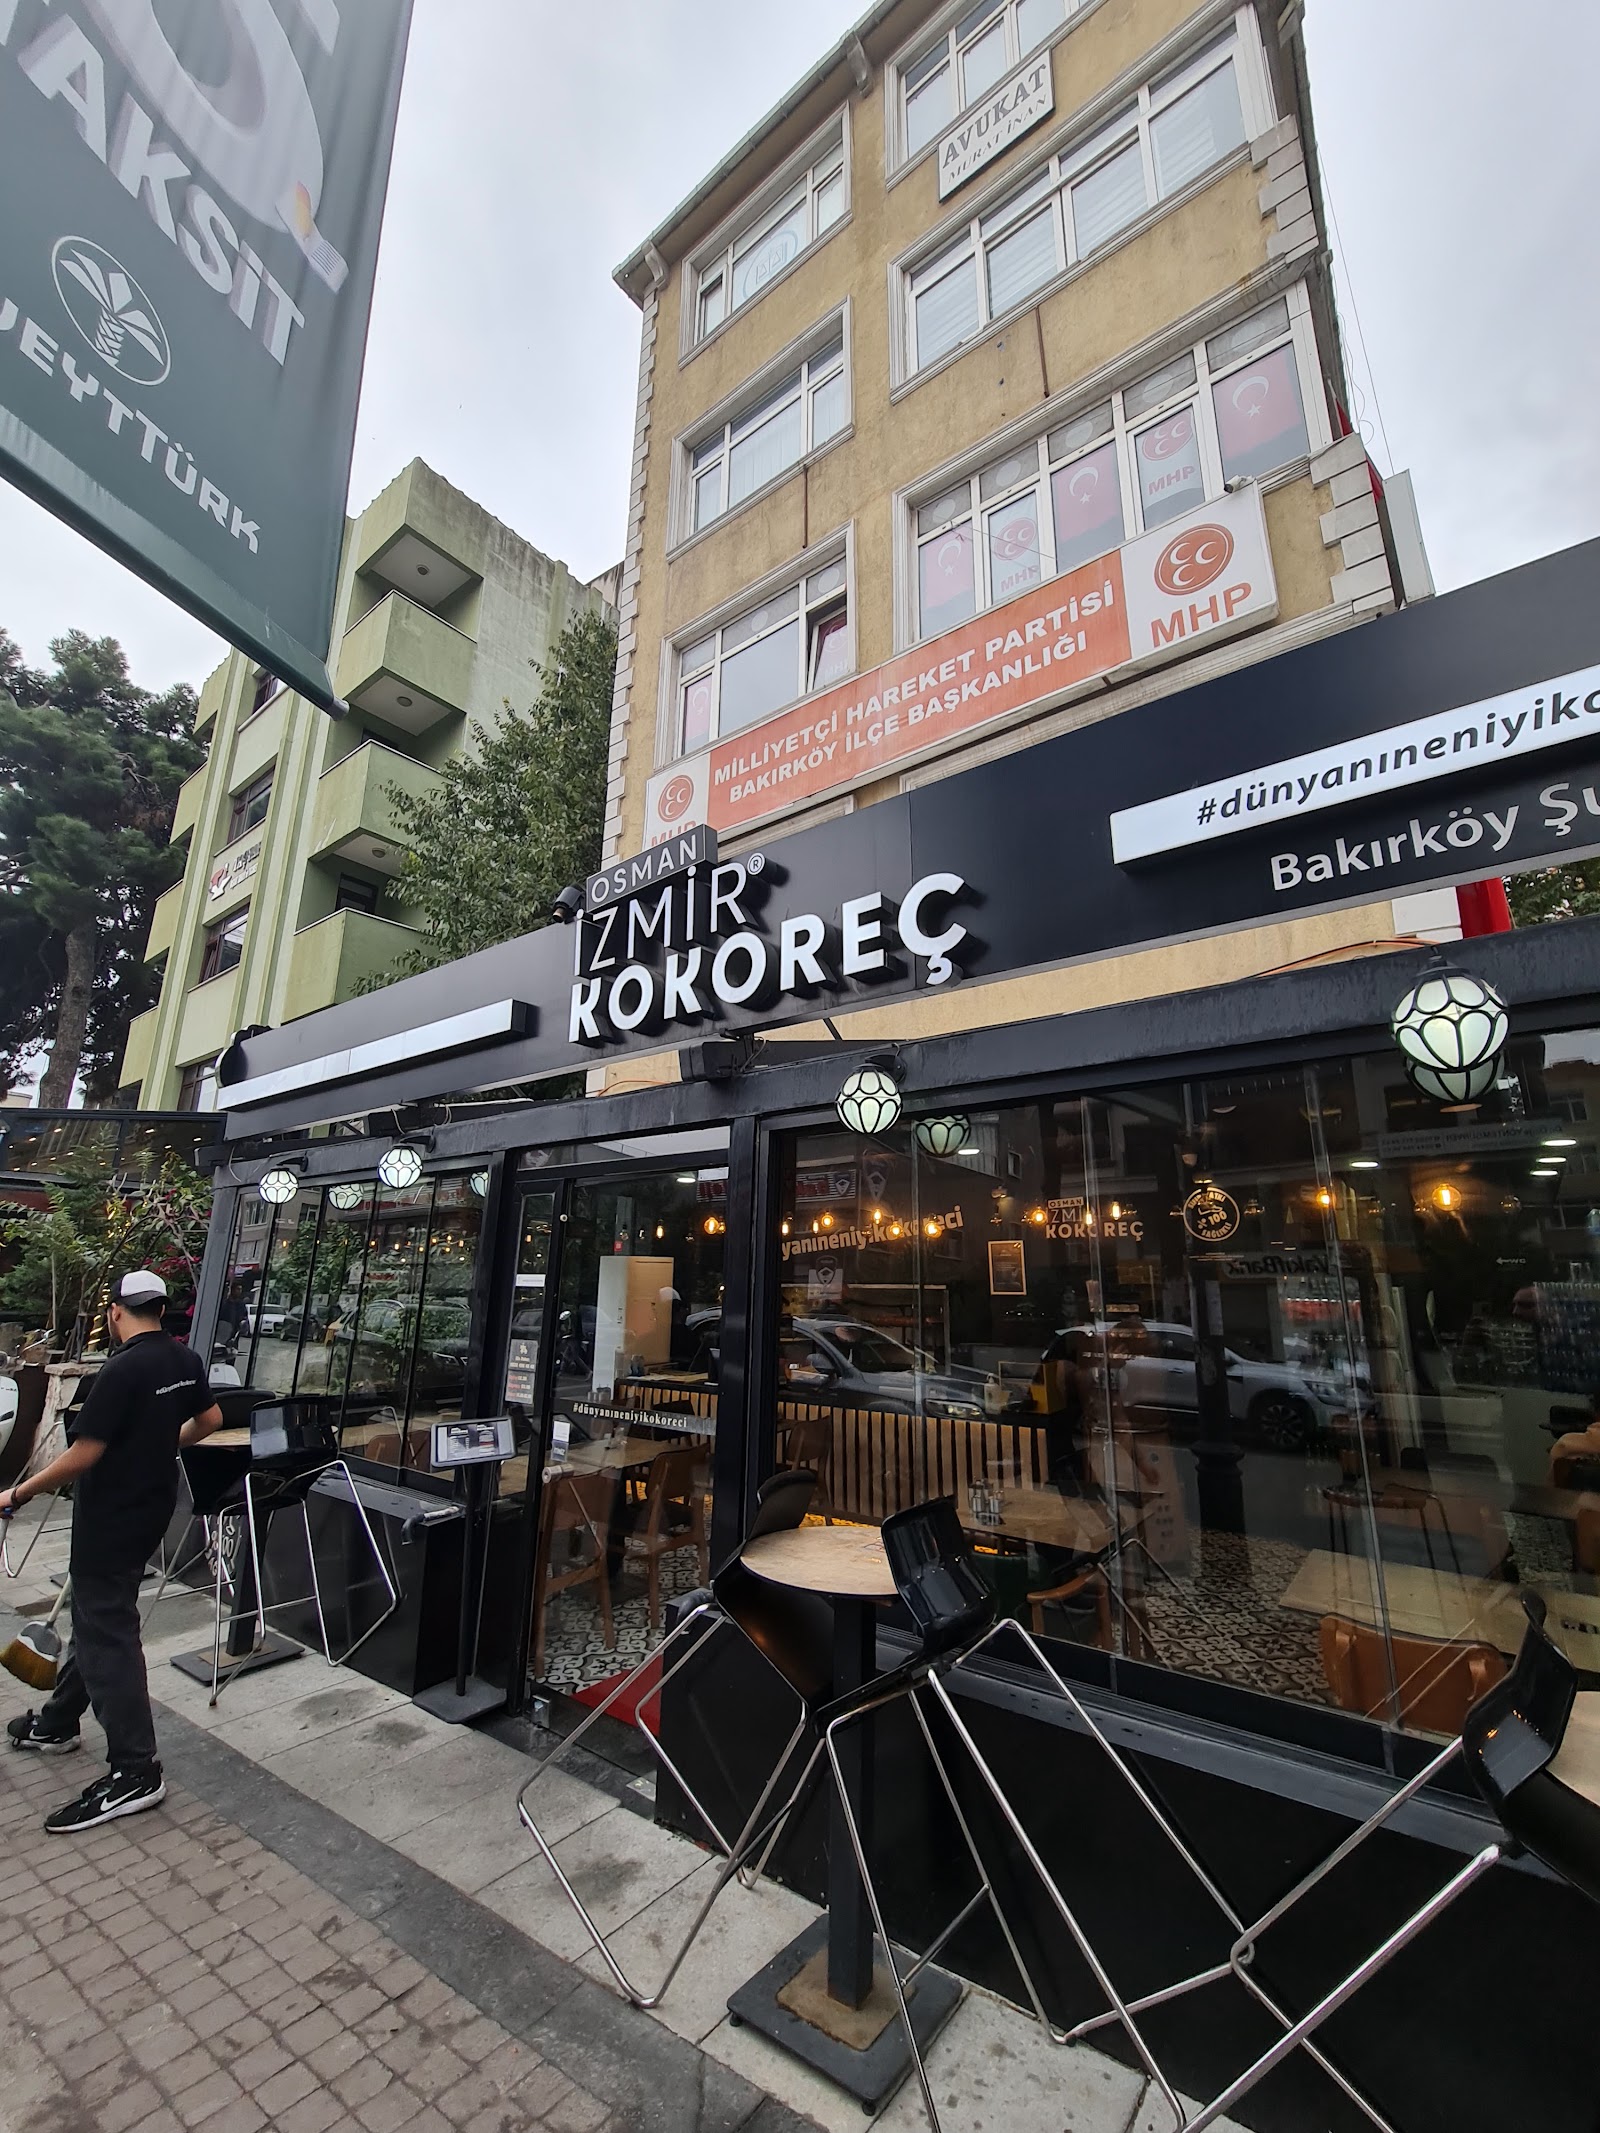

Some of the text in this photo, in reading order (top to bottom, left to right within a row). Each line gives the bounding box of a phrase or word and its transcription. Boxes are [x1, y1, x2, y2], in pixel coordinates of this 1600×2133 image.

[943, 64, 1046, 169] AVUKAT
[949, 94, 1047, 183] MURAT İNAN
[0, 0, 304, 366] AKSİT
[1148, 465, 1196, 496] MHP
[1001, 564, 1040, 592] MHP
[1151, 582, 1252, 648] MHP
[714, 579, 1114, 786] MİLLİYETÇİ HAREKET PARTİSİ
[729, 630, 1087, 803] BAKIRKÖY İLÇE BAŞKANLIĞI
[591, 833, 698, 904] OSMAN
[1270, 804, 1520, 891] Bakırköy
[568, 871, 968, 1044] KOKOREÇ
[1046, 1221, 1144, 1242] KOKOREÇ
[1049, 1198, 1082, 1208] OSMAN
